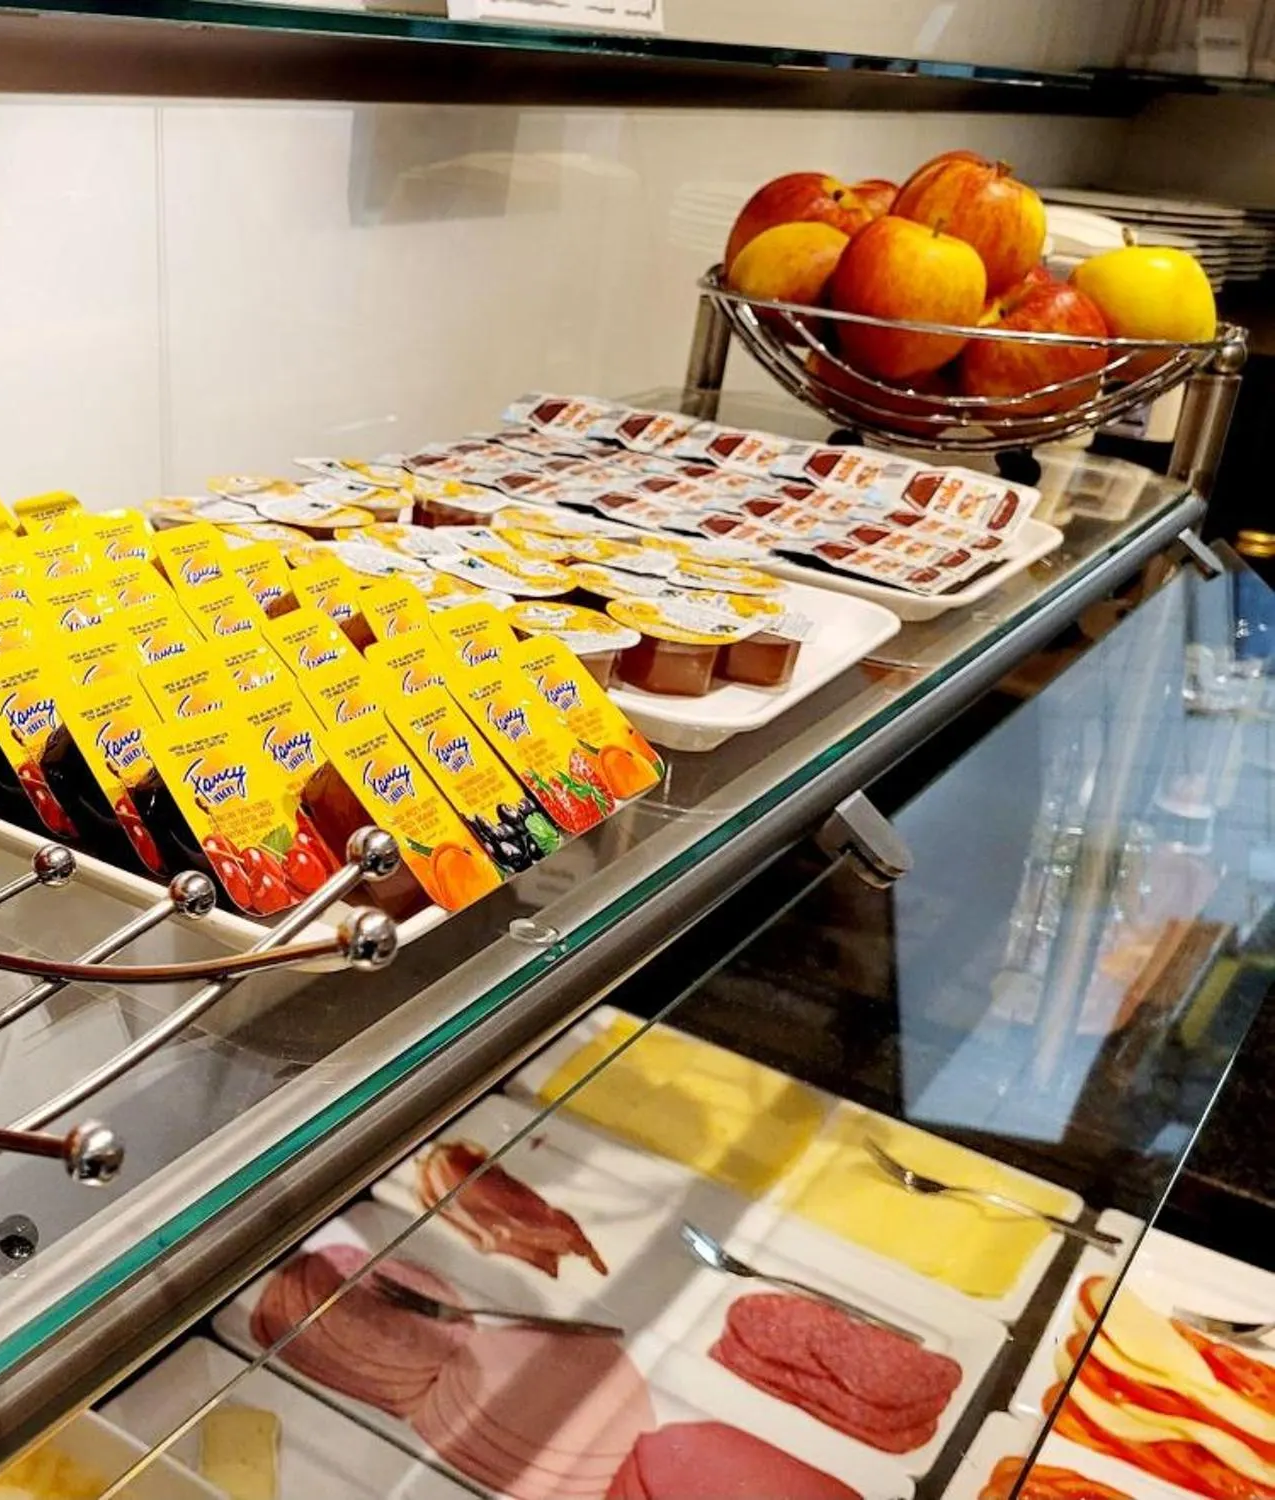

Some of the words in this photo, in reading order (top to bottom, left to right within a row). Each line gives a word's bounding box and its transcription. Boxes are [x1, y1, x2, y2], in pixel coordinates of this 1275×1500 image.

[0, 692, 56, 731] Fancy
[263, 726, 315, 764] Fancy
[427, 730, 474, 767] Fancy
[183, 758, 247, 798] Fancy
[363, 759, 416, 798] Fancy
